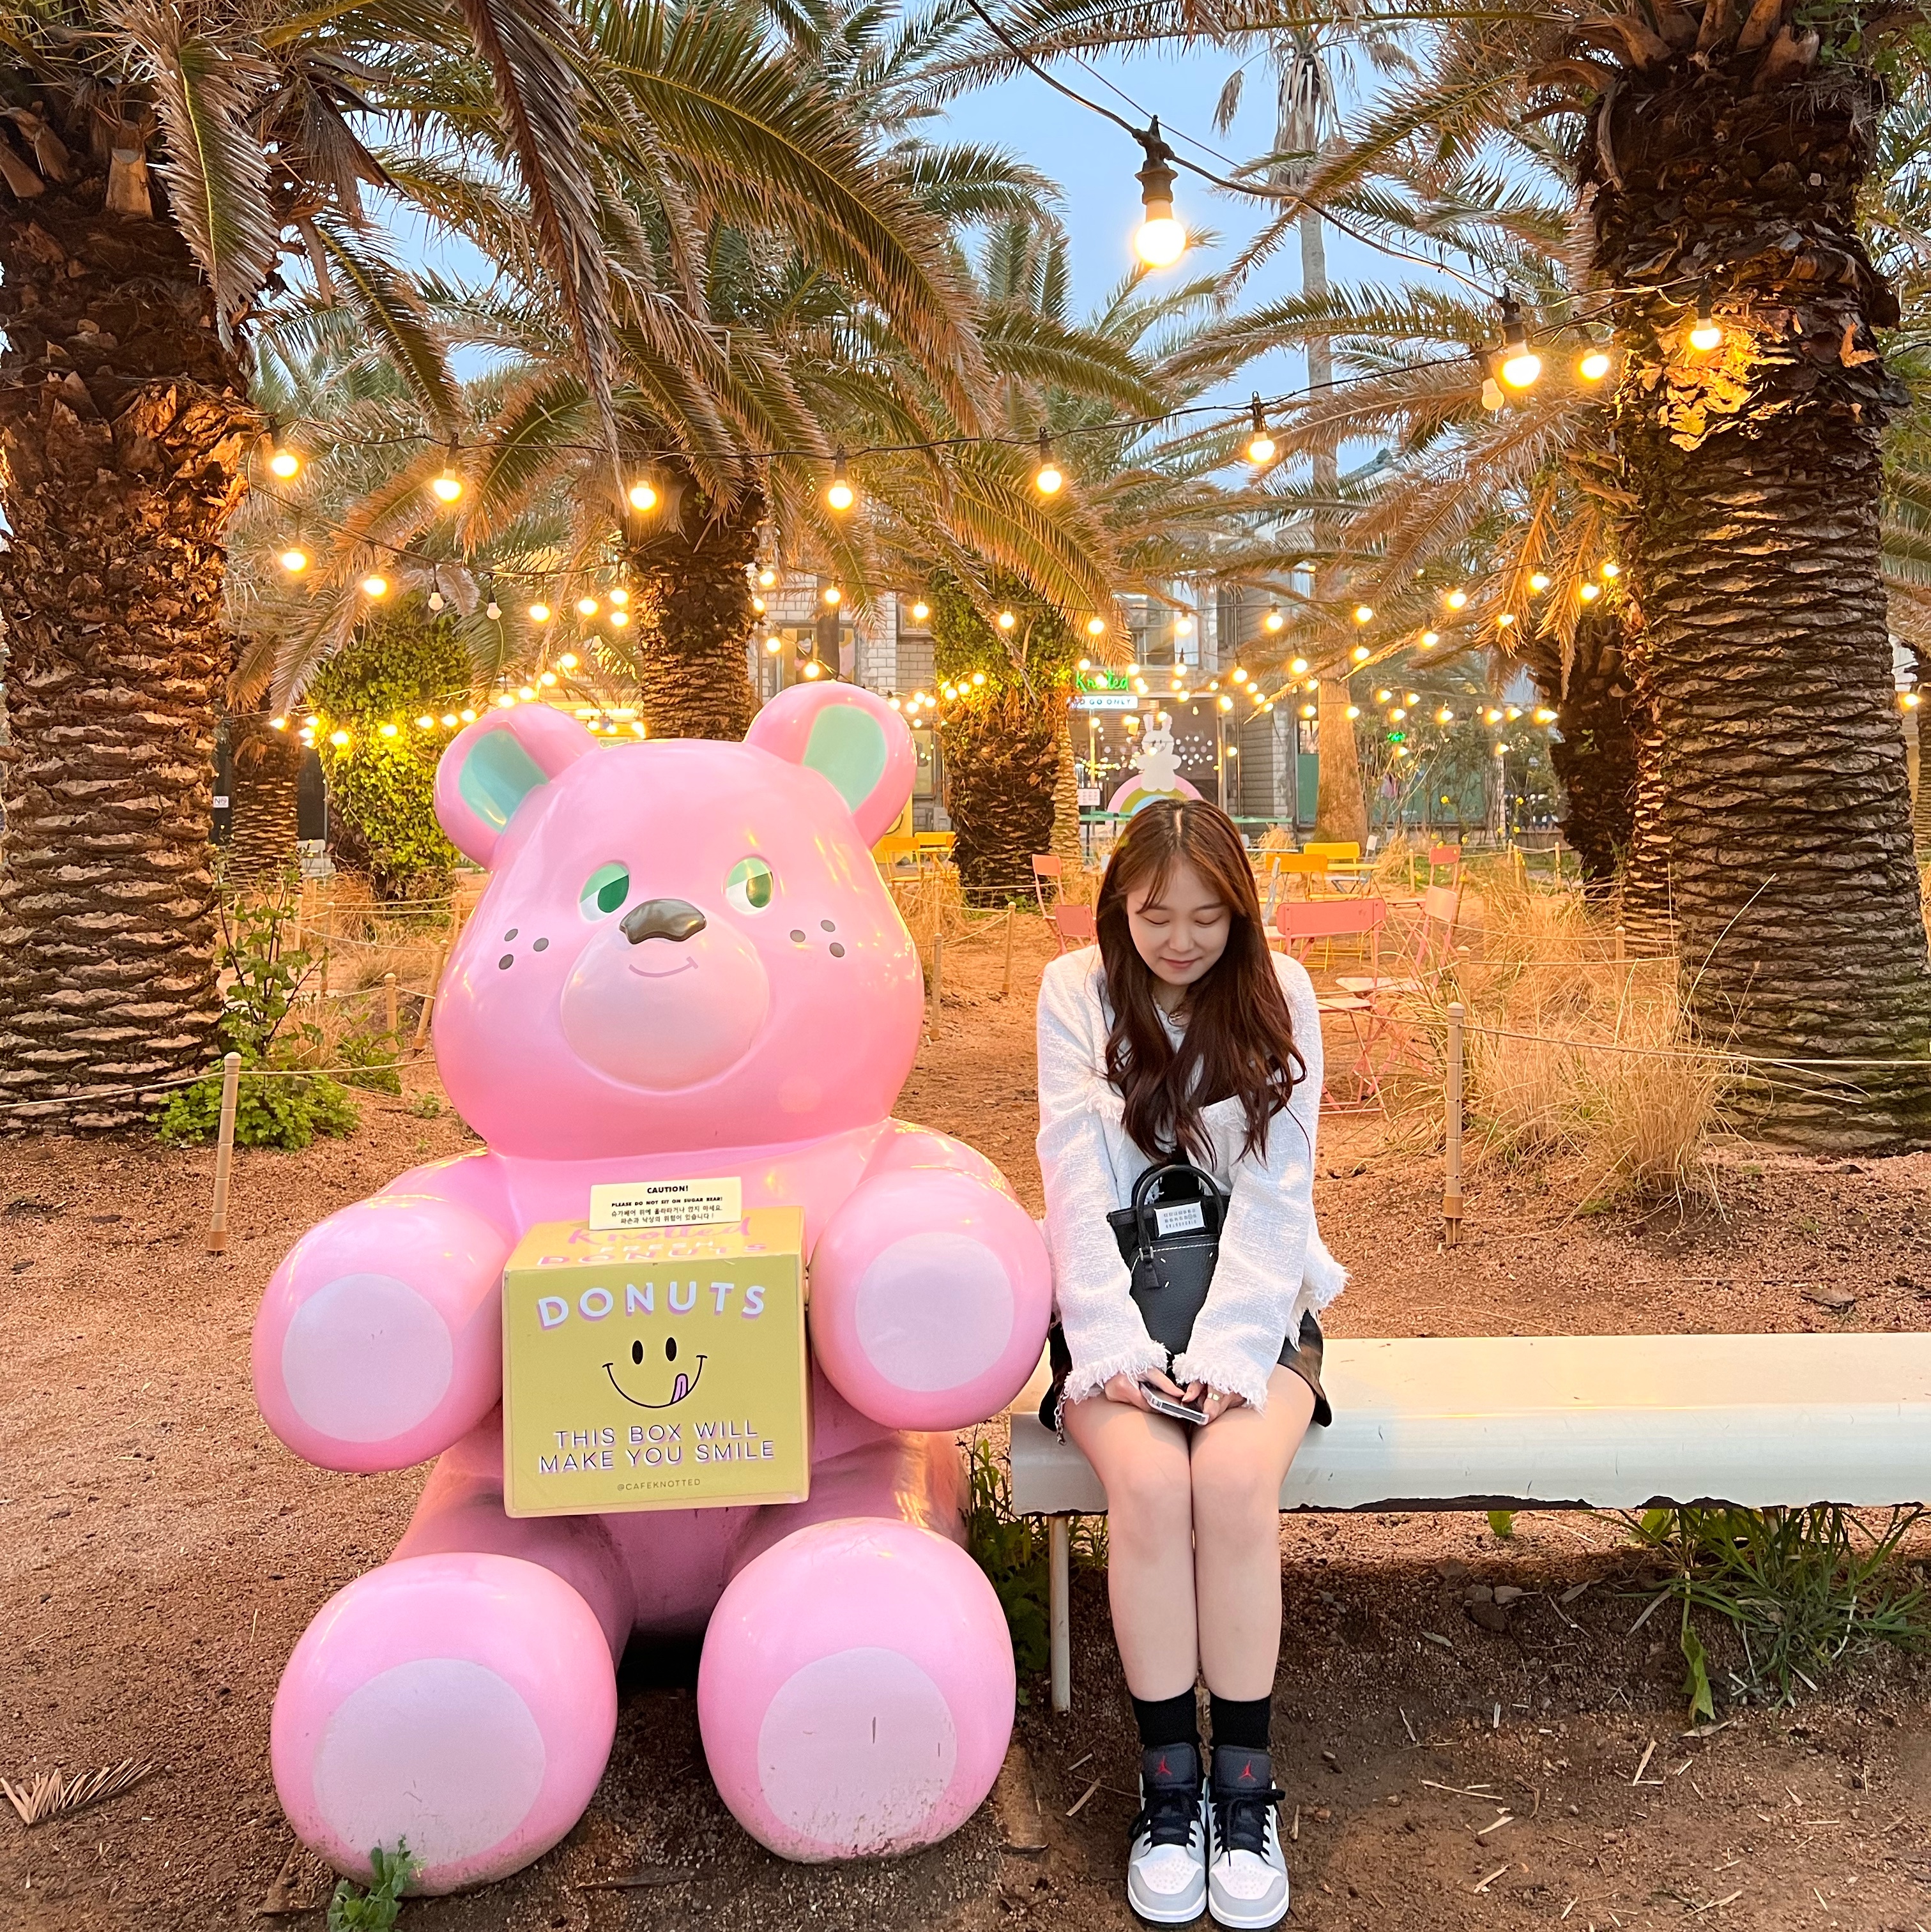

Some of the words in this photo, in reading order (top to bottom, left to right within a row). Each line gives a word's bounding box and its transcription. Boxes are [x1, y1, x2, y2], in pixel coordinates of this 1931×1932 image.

[647, 1185, 689, 1194] CAUTION!
[611, 1209, 636, 1217] 슈가베어
[655, 1206, 685, 1215] 올라타거나
[536, 1243, 767, 1266] DONUTS
[537, 1281, 765, 1329] DONUTS
[554, 1427, 616, 1449] THIS
[629, 1424, 682, 1445] BOX
[694, 1419, 759, 1440] WILL
[539, 1450, 614, 1474] MAKE
[625, 1446, 682, 1468] YOU
[696, 1440, 775, 1463] SMILE
[617, 1479, 701, 1492] @CAFEKNOTTED
